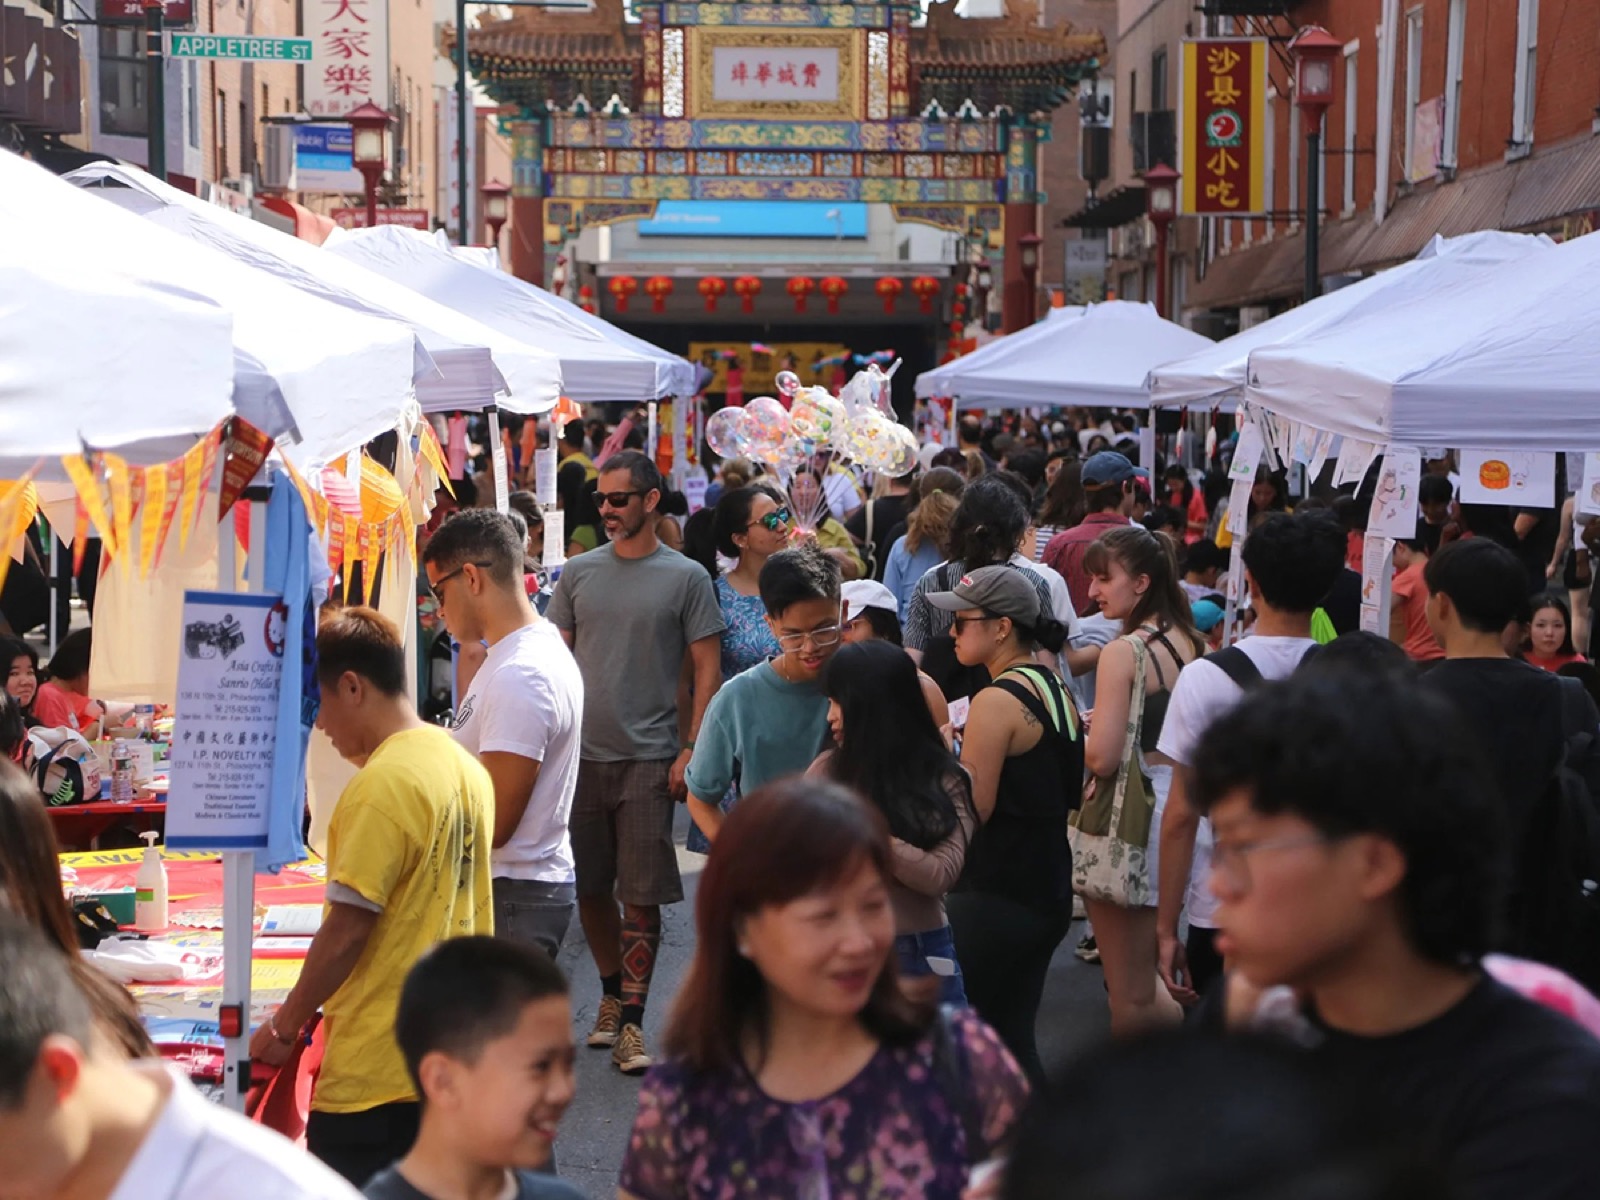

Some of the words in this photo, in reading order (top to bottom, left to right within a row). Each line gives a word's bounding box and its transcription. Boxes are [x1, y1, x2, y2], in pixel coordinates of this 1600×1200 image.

[177, 37, 284, 58] APPLETREE
[291, 45, 308, 58] ST
[226, 660, 249, 673] Asia
[217, 677, 249, 689] Sanrio
[213, 751, 256, 761] NOVELTY
